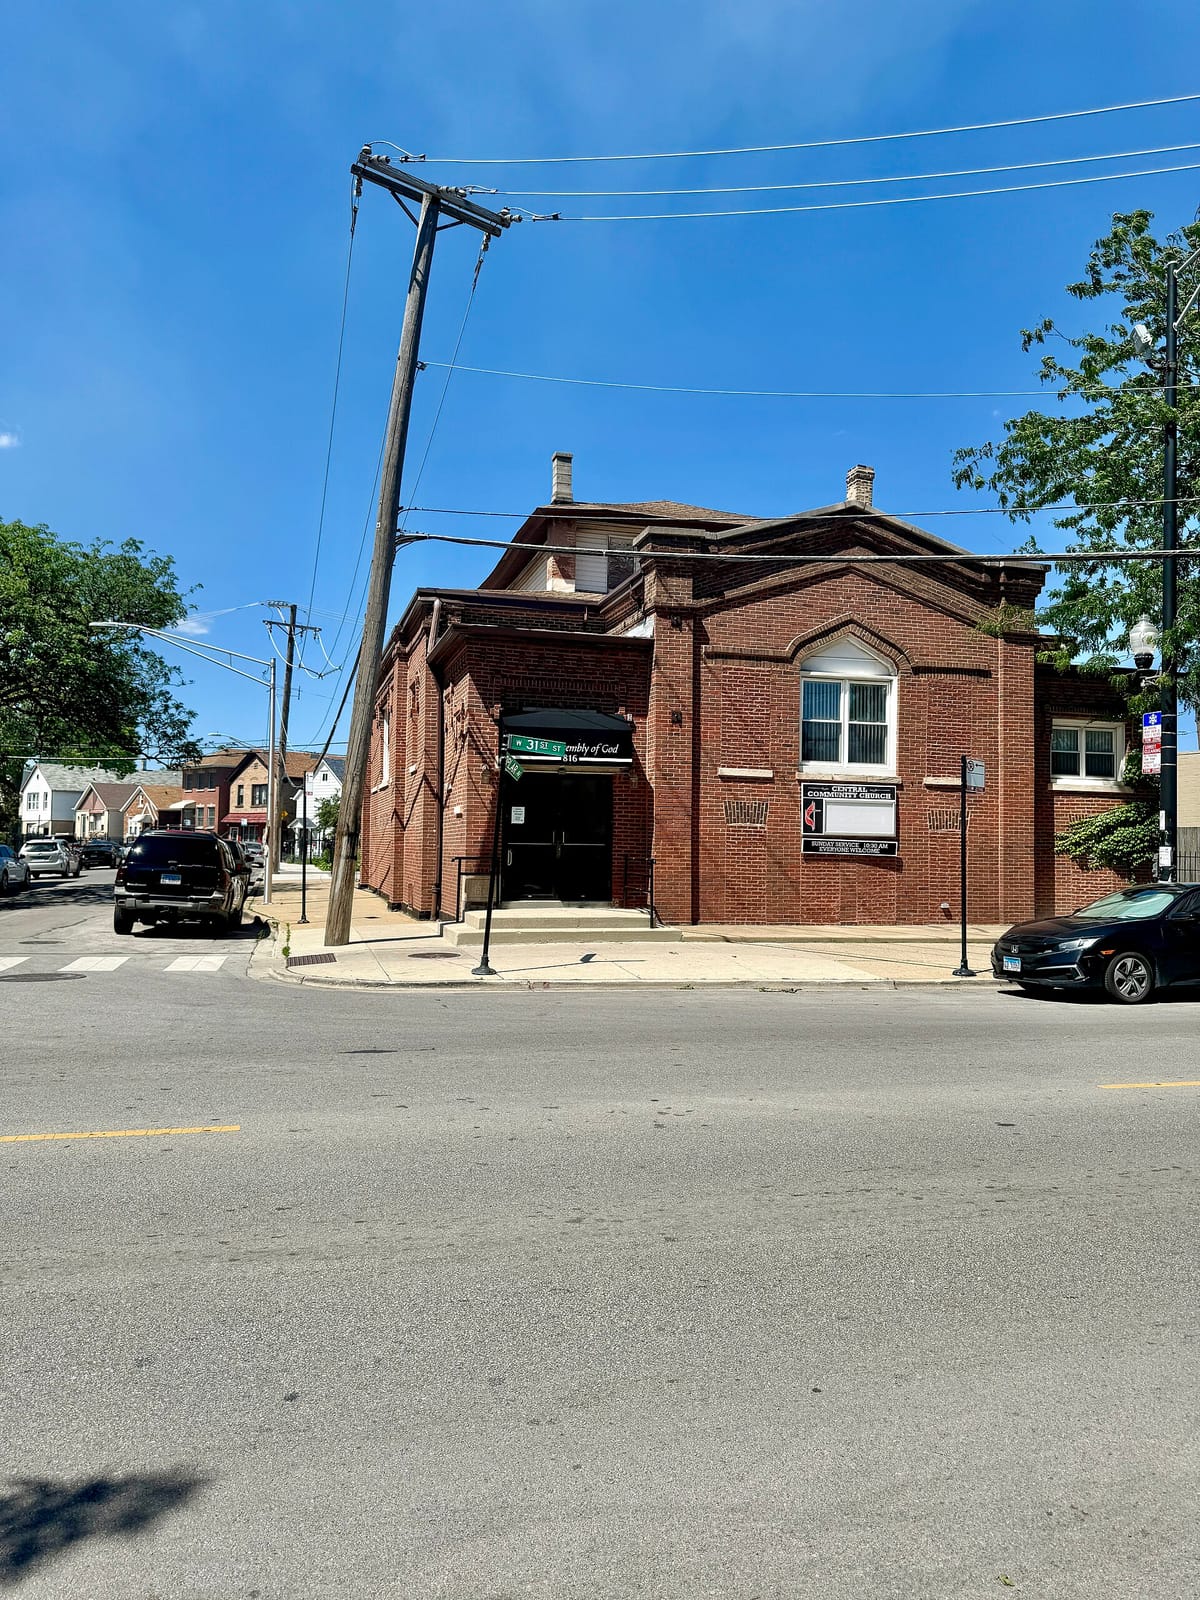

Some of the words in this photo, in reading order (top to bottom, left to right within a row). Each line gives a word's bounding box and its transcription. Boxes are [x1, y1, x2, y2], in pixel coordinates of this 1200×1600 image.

[526, 739, 548, 750] 31ST
[565, 742, 589, 756] embly
[590, 743, 602, 756] of
[601, 744, 619, 754] God
[562, 754, 578, 762] 816
[831, 785, 868, 793] CENTRAL
